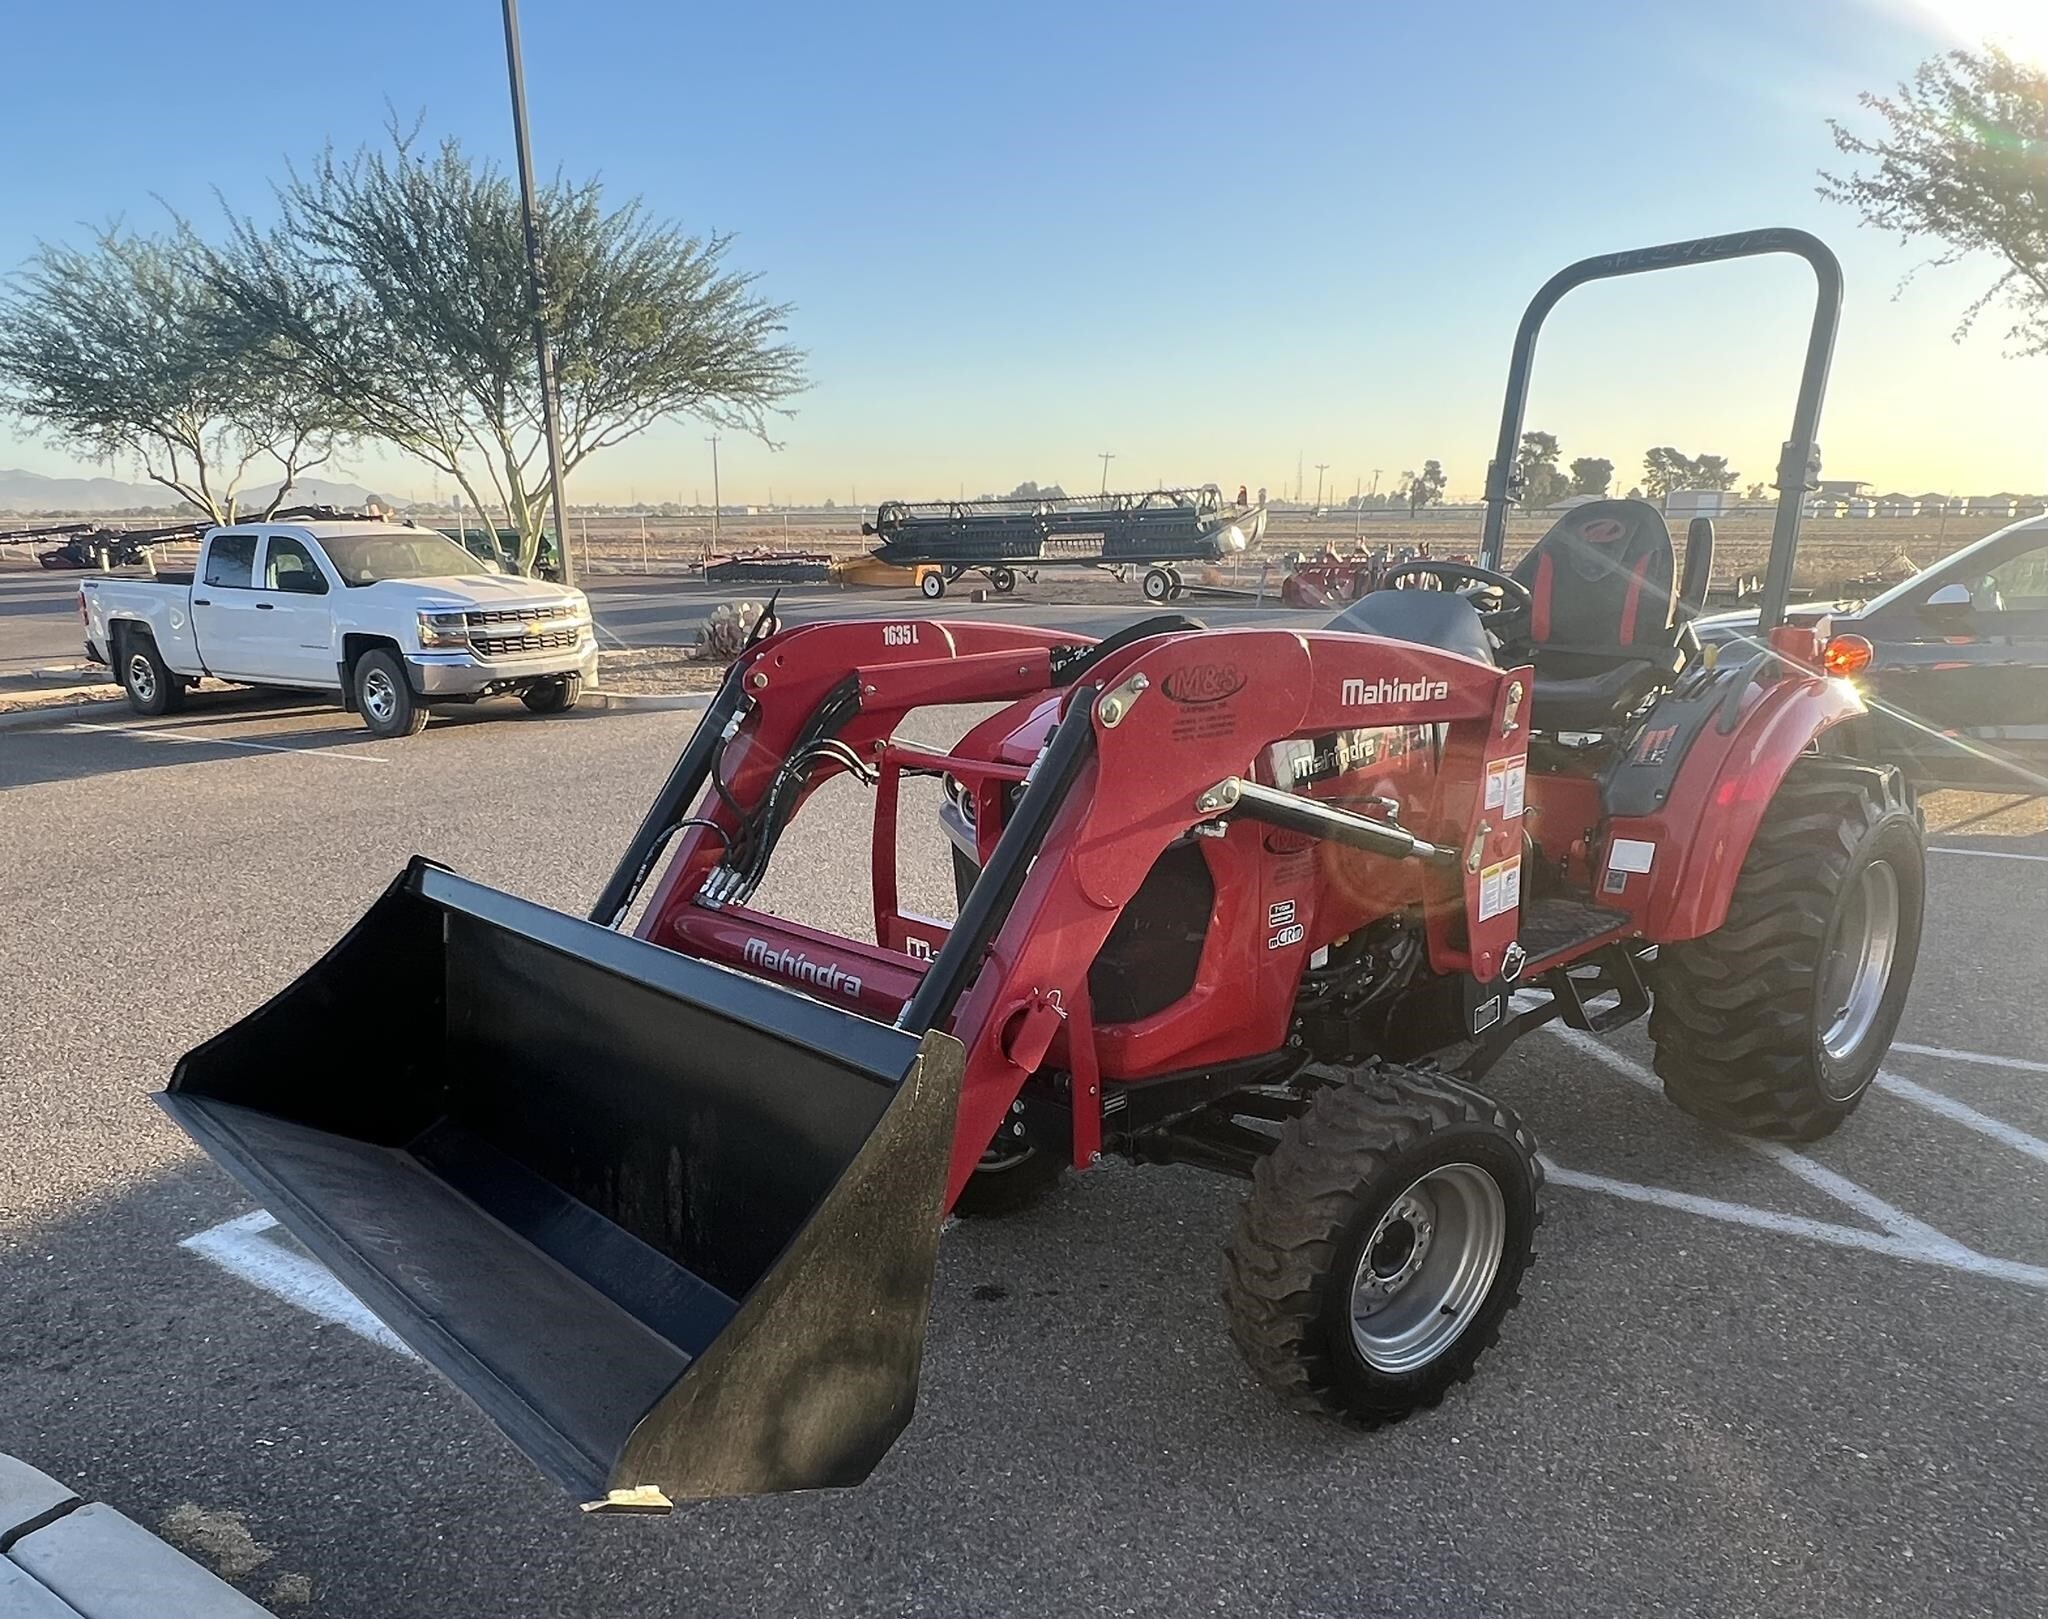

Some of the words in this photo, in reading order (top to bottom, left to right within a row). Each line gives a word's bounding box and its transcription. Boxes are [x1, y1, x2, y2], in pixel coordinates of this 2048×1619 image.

[882, 625, 920, 646] 1635L
[1173, 665, 1237, 699] M&S
[1341, 676, 1449, 706] Mahindra
[1293, 739, 1376, 779] Mahindra
[743, 937, 863, 998] Mahindra
